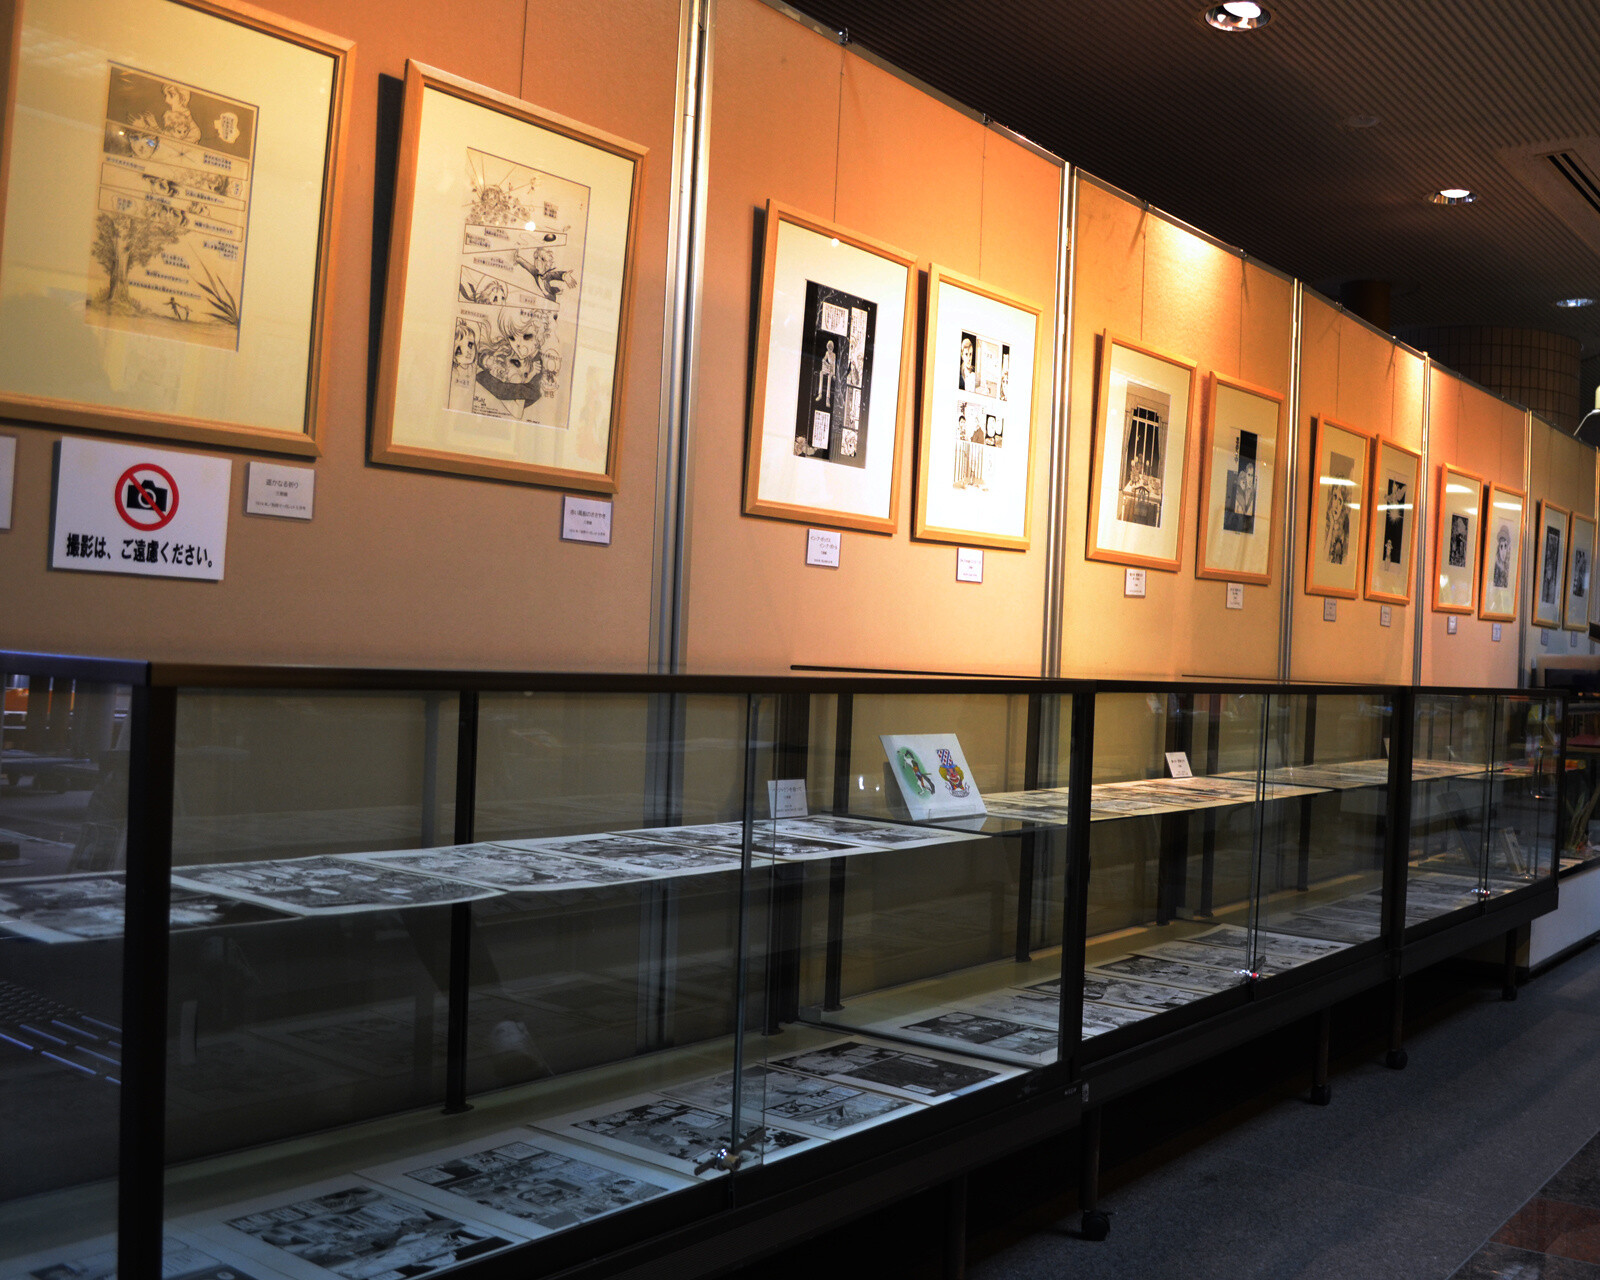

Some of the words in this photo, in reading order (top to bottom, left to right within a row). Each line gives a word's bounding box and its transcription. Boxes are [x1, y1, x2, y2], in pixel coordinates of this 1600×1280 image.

[66, 532, 212, 568] 撮影は、ご遠慮ください。
